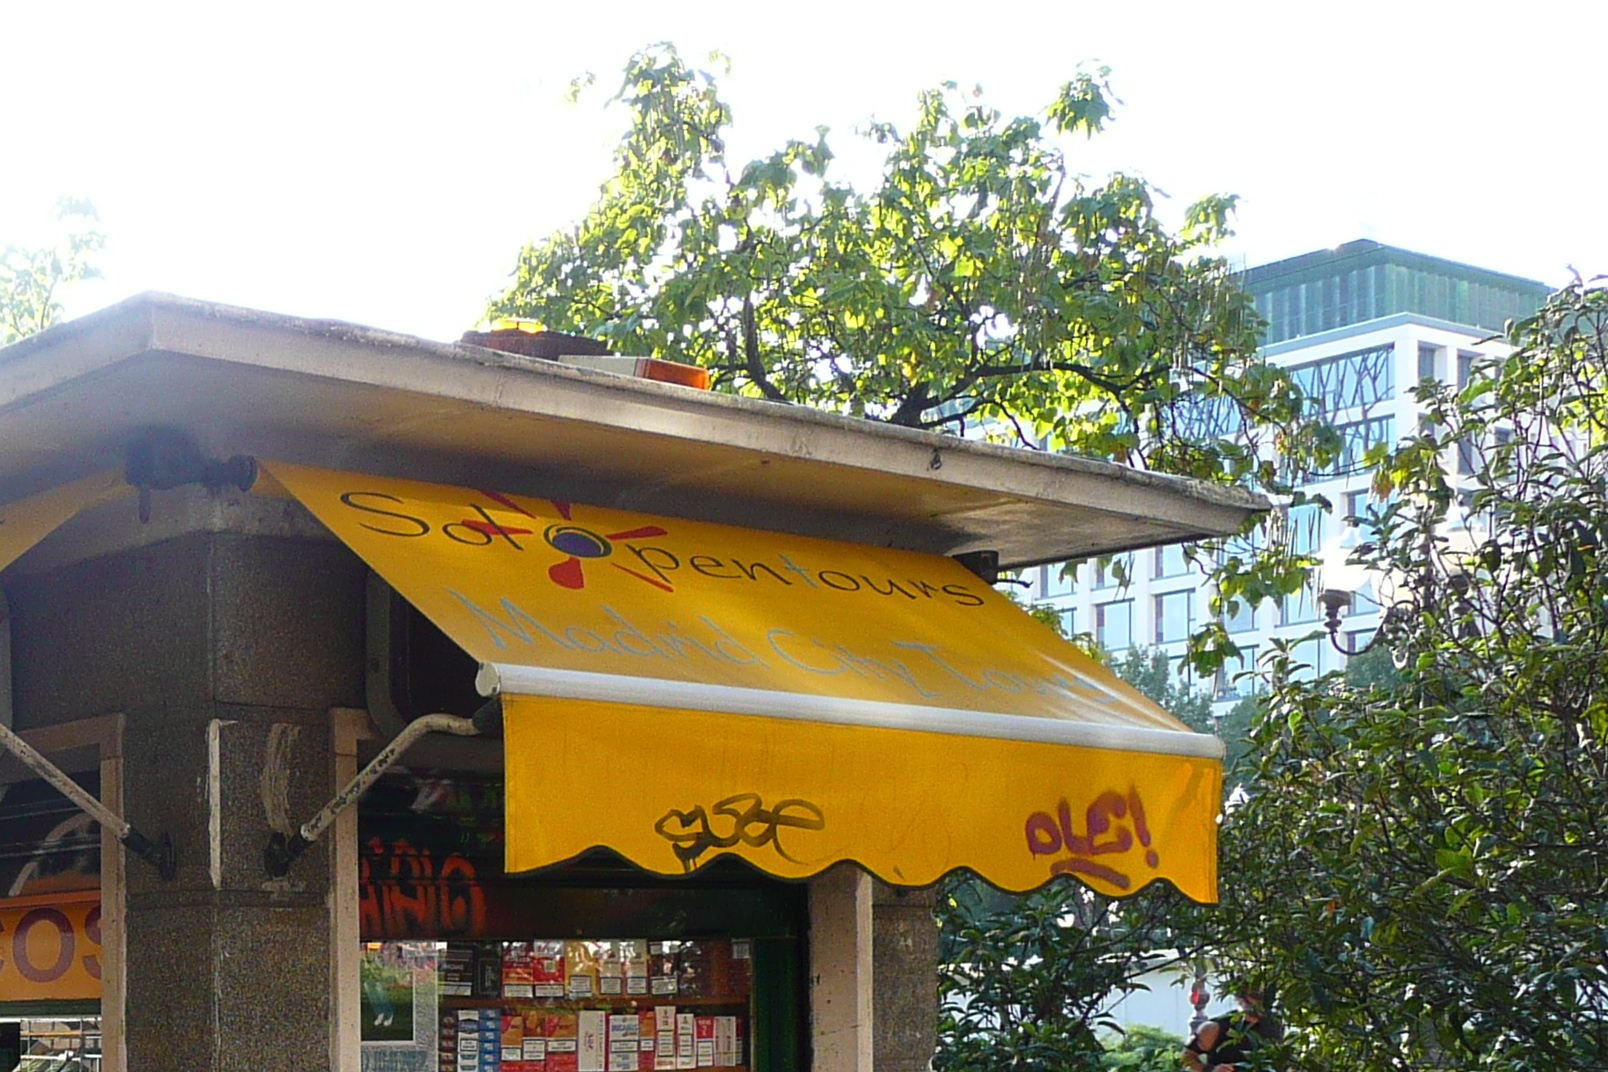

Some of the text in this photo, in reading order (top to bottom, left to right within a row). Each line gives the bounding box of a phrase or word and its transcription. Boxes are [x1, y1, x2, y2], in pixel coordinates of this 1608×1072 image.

[445, 586, 1118, 702] Madrid City Tours
